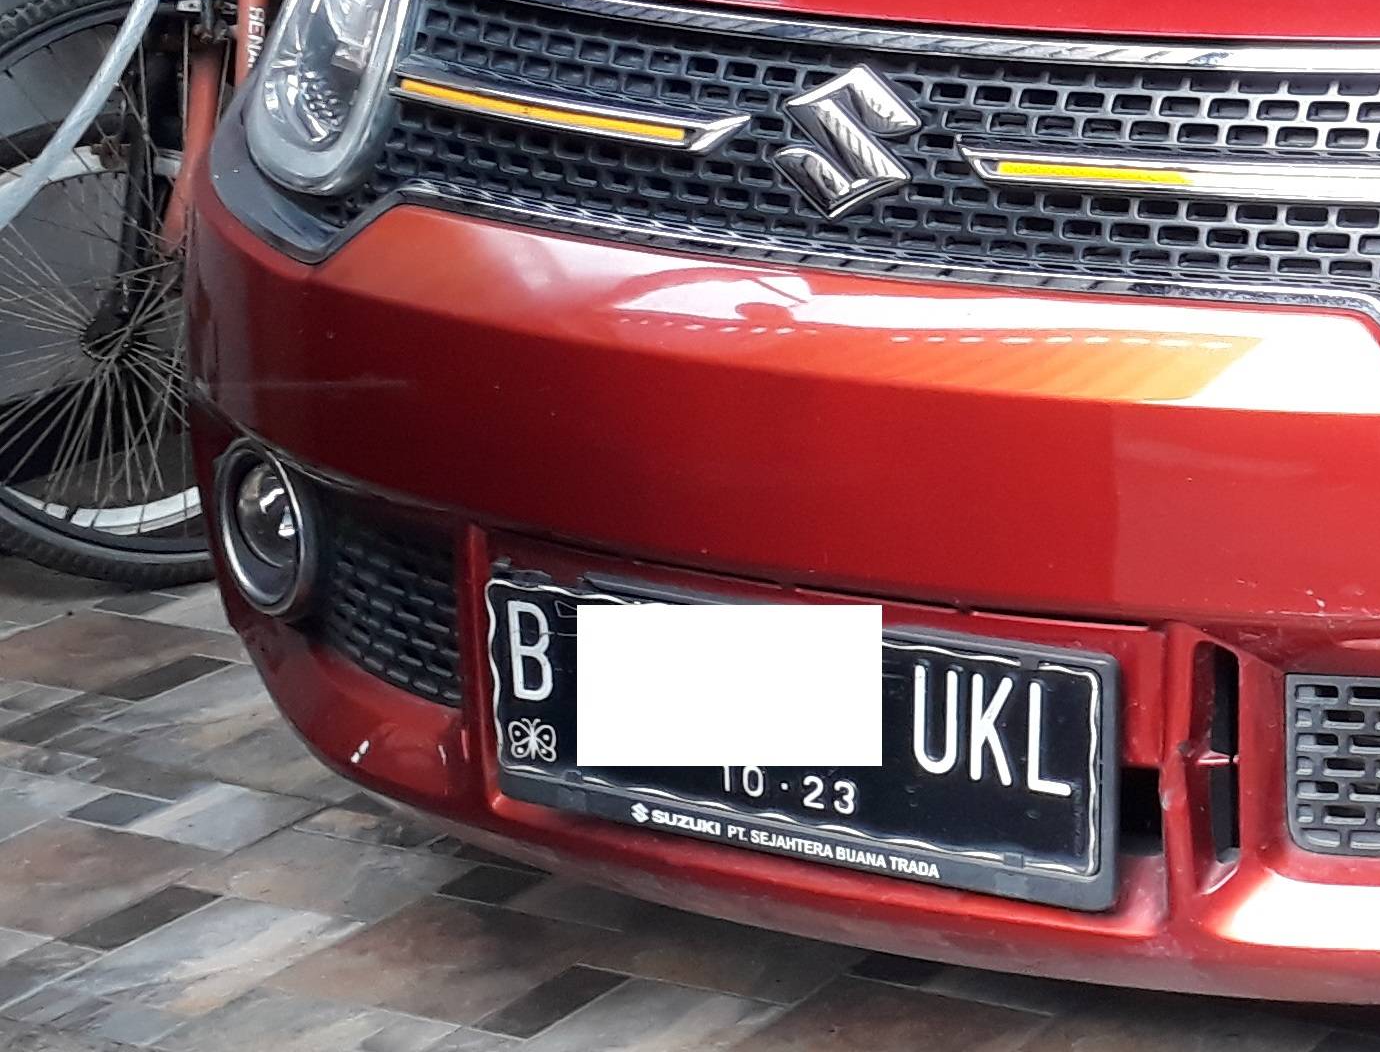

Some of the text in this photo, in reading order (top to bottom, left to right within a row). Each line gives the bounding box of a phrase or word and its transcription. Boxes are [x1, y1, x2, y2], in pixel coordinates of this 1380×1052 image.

[507, 600, 1072, 797] B UKL
[651, 809, 721, 836] SUZUKI
[727, 824, 748, 842] PT.
[750, 829, 833, 859] SEJAHTERA
[835, 846, 887, 869] BUANA
[889, 855, 940, 879] TRADA
